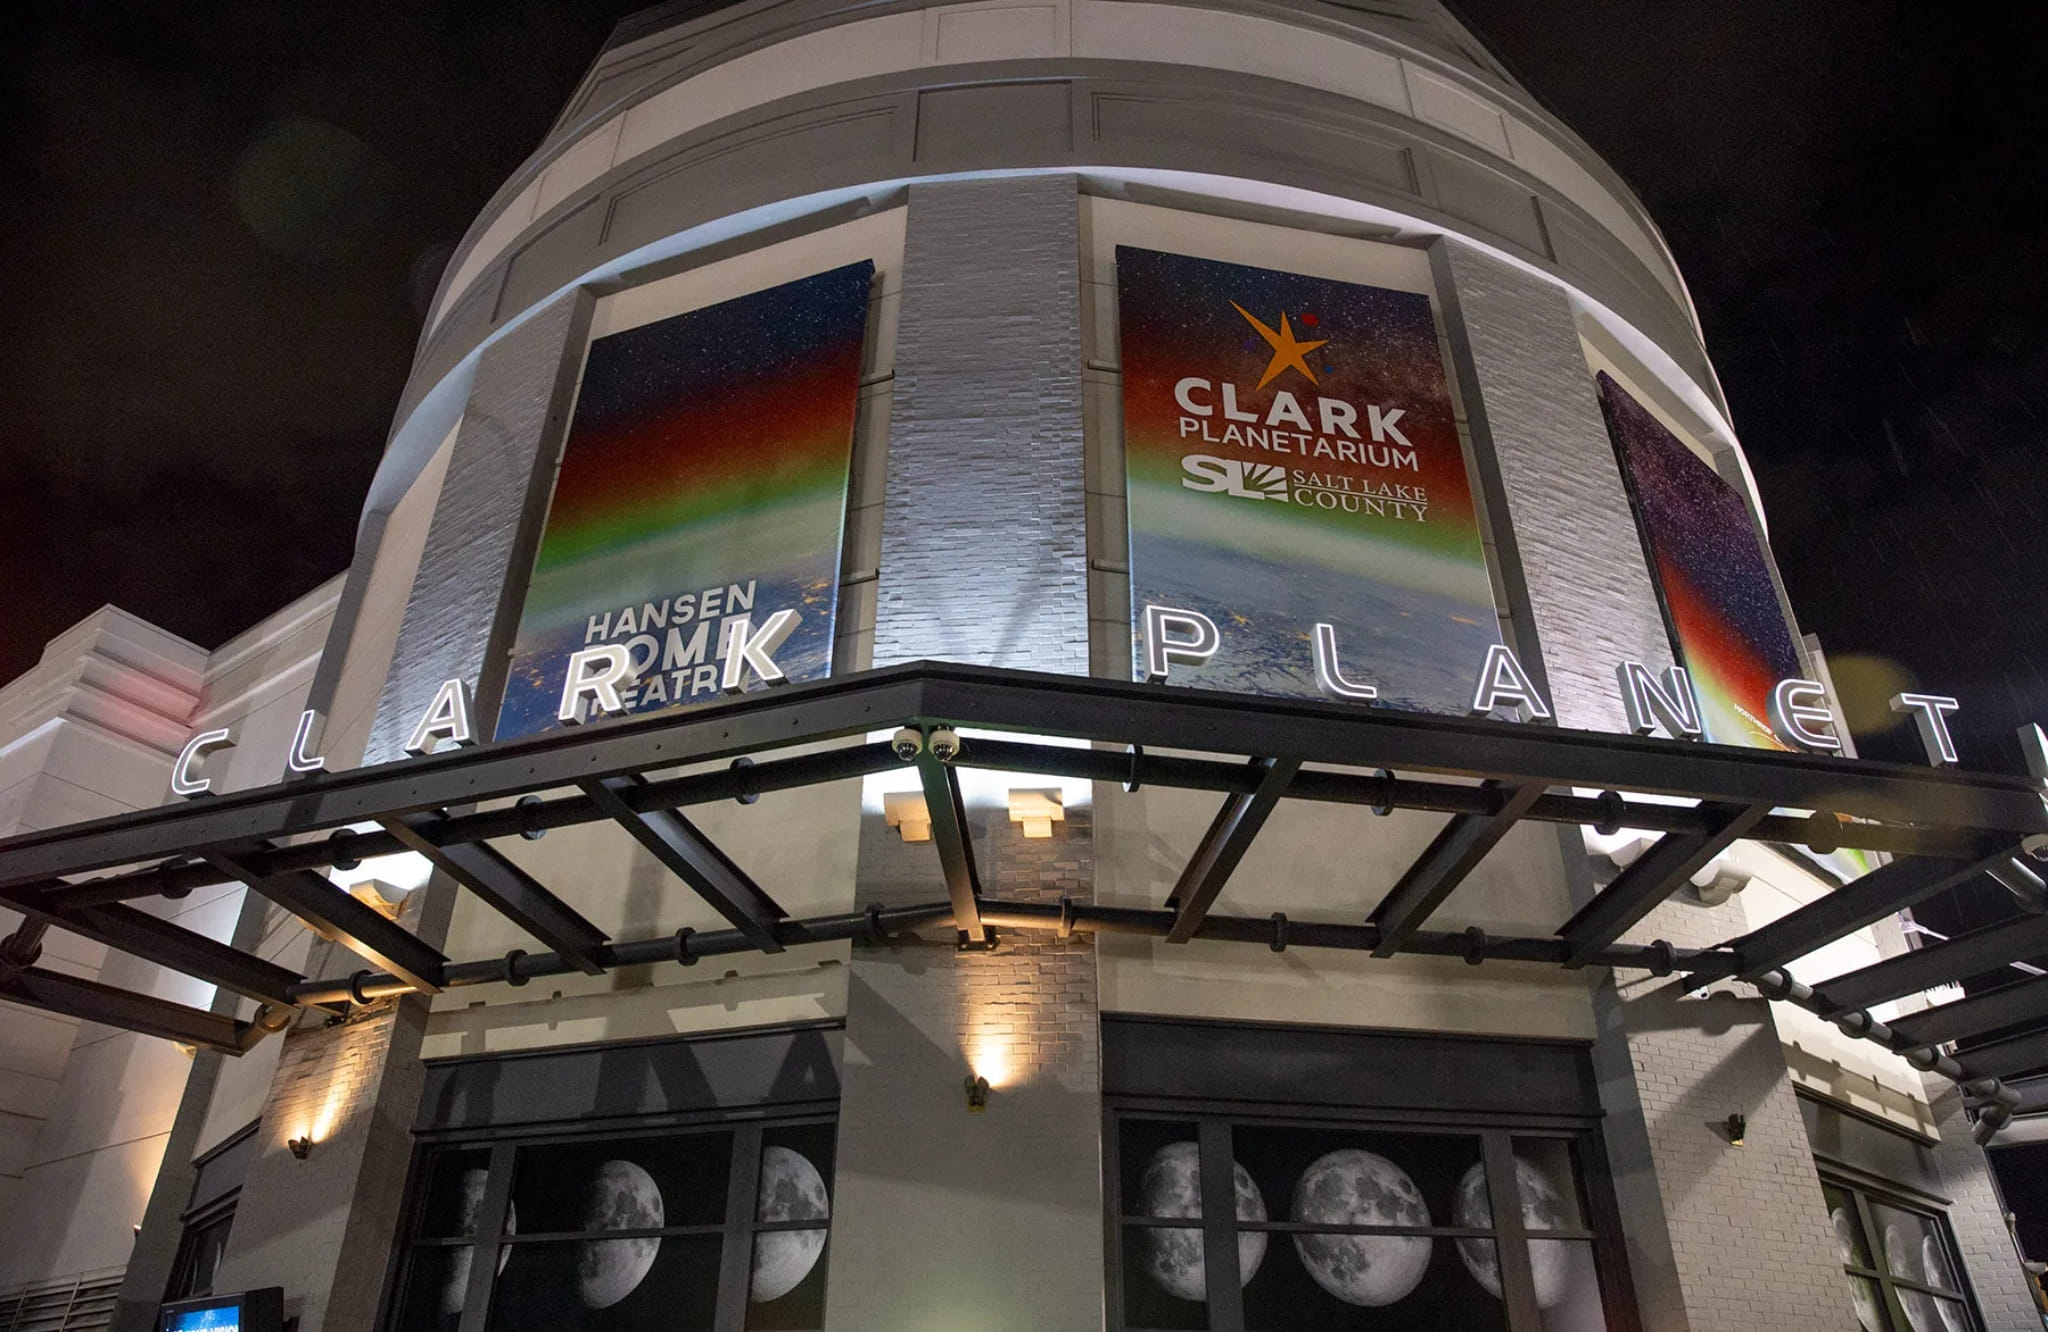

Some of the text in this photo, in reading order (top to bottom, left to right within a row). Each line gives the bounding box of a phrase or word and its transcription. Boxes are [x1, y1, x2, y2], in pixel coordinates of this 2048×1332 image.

[1174, 376, 1414, 447] CLARK
[1179, 416, 1419, 472] PLANETARIUM
[1292, 469, 1428, 502] SALT LAKE
[1294, 488, 1428, 522] COUNTY
[584, 580, 756, 644] HANSEN
